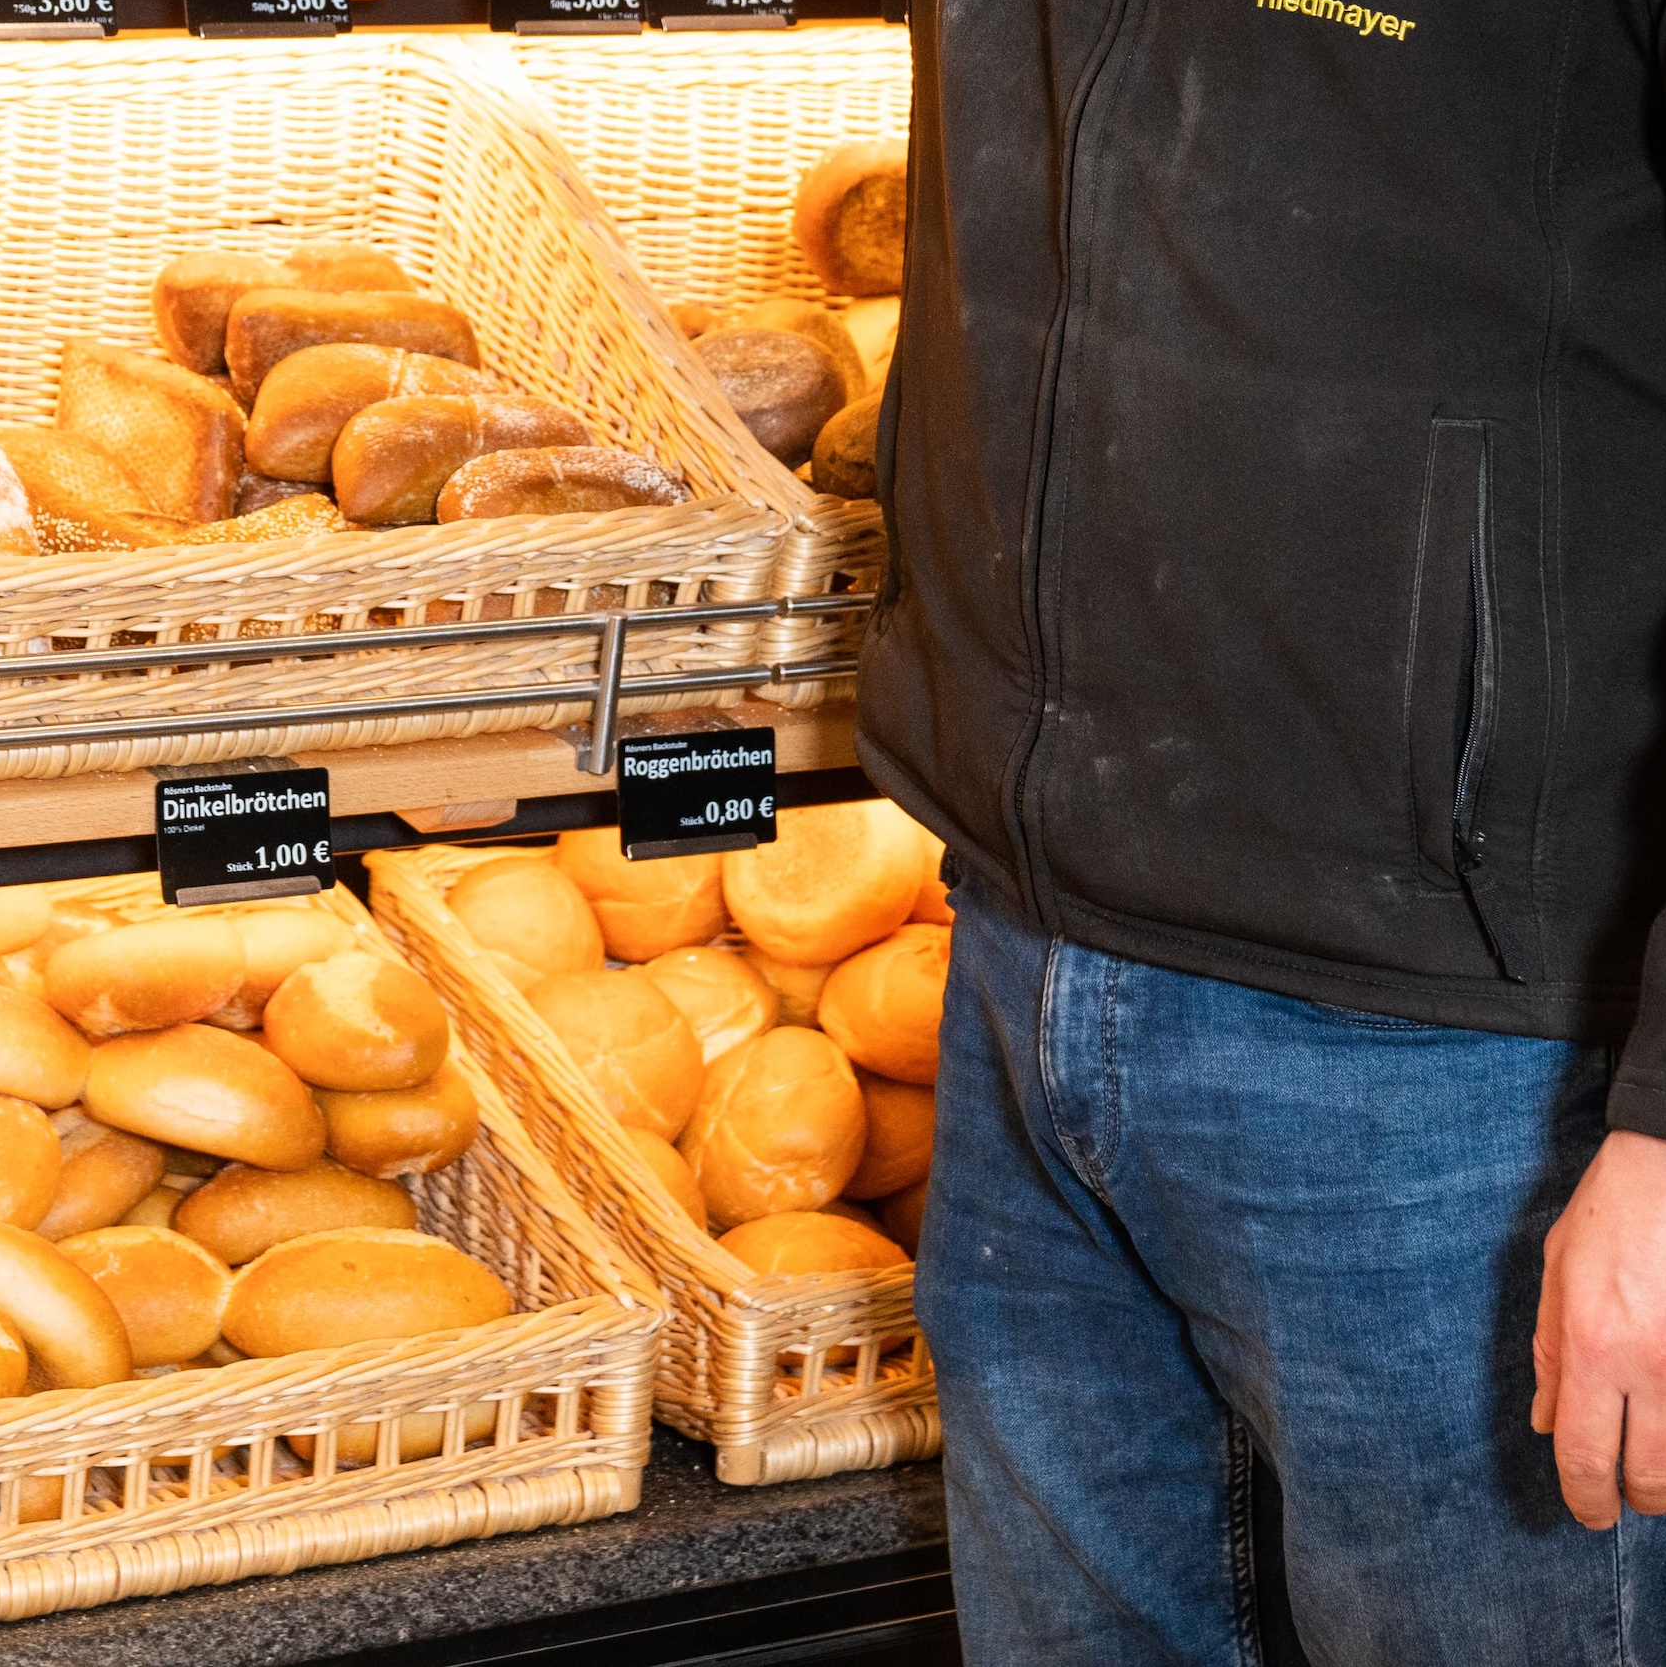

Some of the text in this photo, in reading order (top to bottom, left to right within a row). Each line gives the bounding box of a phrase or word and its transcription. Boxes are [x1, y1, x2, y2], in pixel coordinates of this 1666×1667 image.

[13, 3, 37, 15] 750g
[251, 1, 275, 13] 500g
[624, 746, 773, 780] Roggenbrötchen
[163, 782, 233, 795] Rösners Backstube
[163, 788, 326, 821] Dinkelbrötchen
[679, 795, 774, 827] Stück 0,80 €
[183, 824, 205, 833] Dinkel
[226, 840, 331, 873] Stück 1,00 €
